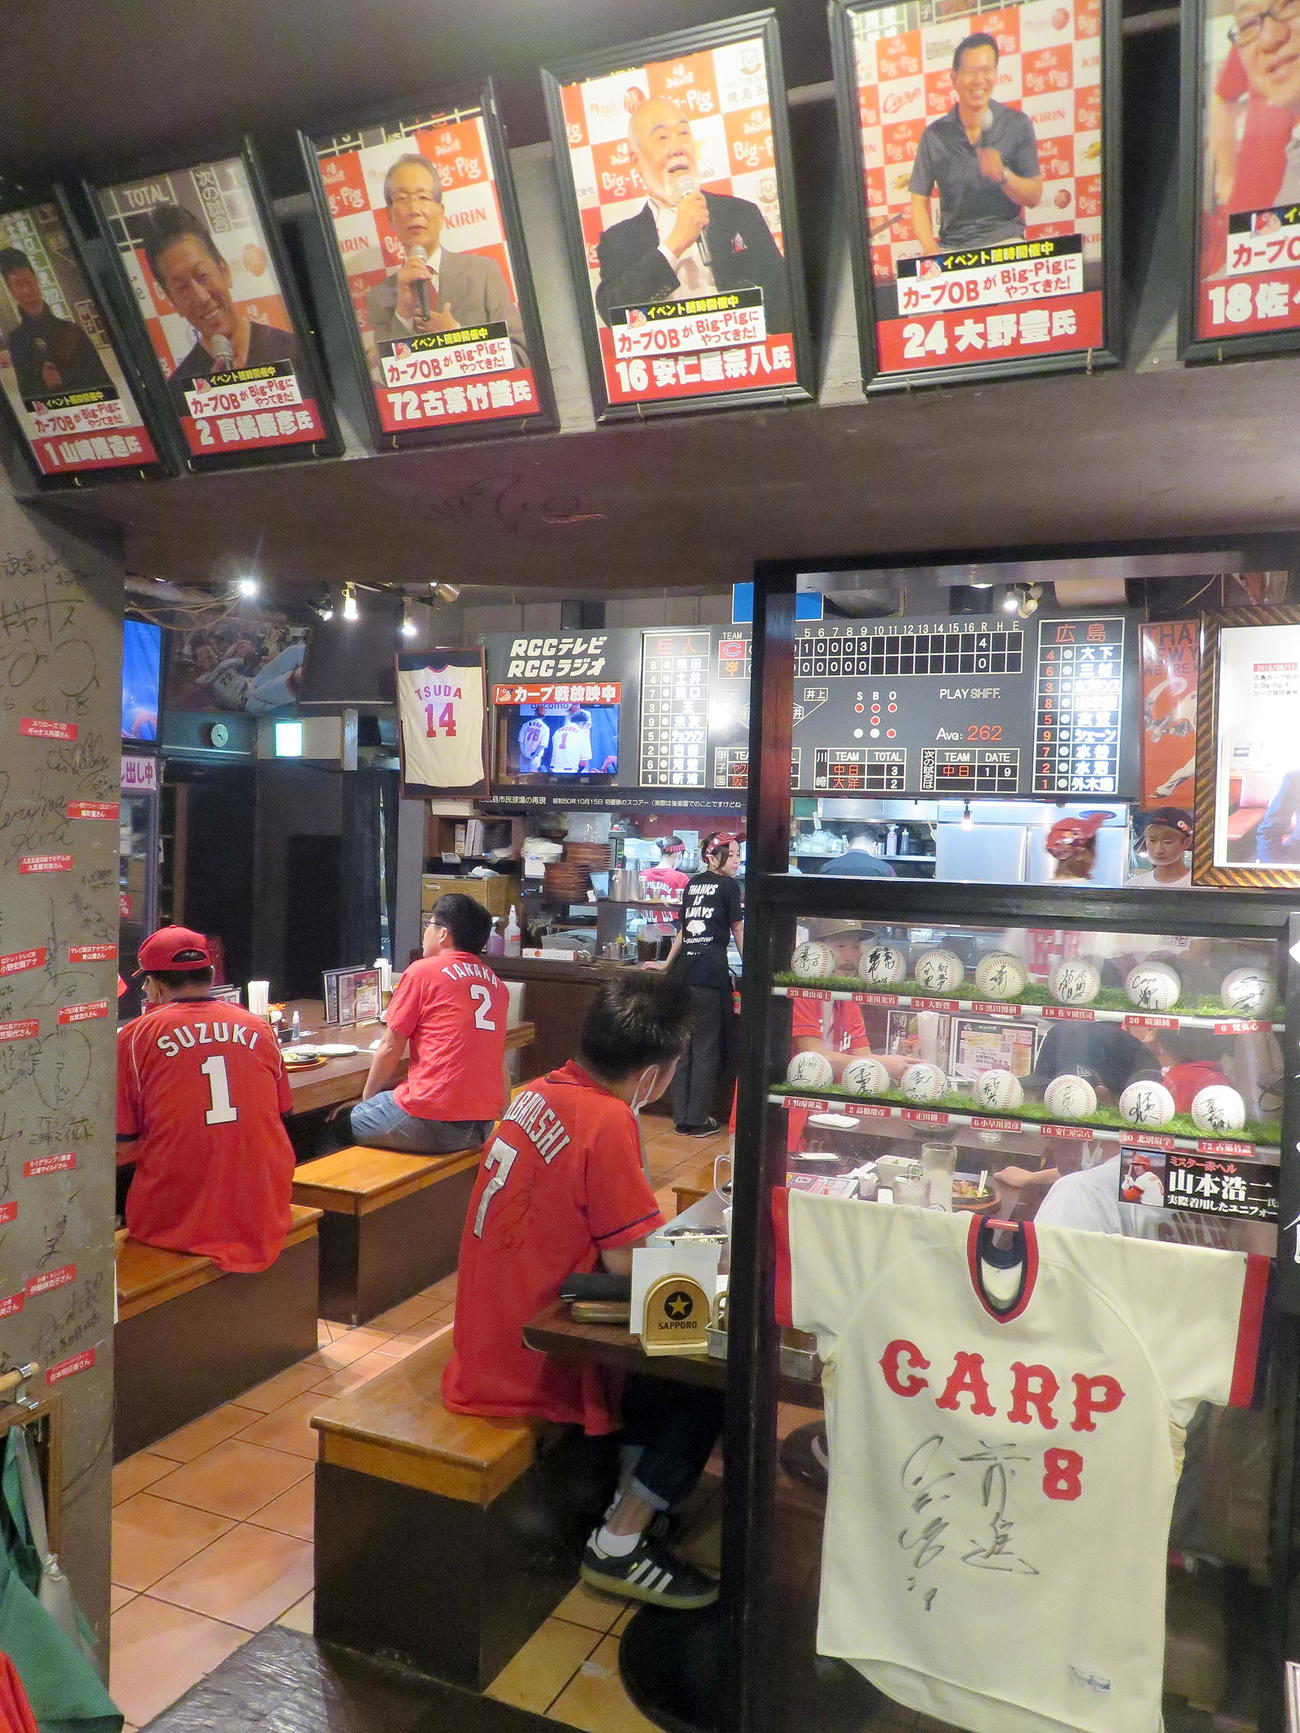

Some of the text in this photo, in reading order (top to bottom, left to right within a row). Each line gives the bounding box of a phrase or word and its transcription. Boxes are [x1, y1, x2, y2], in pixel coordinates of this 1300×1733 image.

[124, 184, 171, 208] TOTAL
[445, 208, 487, 229] KIRIN
[1209, 283, 1252, 324] 18
[902, 320, 948, 358] 24
[615, 359, 649, 393] 16
[387, 391, 421, 421] 72
[196, 419, 215, 445] 2
[44, 442, 60, 466] 1
[804, 629, 810, 637] 5
[833, 628, 839, 636] 7
[847, 627, 853, 636] 8
[861, 627, 867, 635] 9
[874, 626, 884, 635] 10
[888, 626, 898, 635] 11
[903, 626, 913, 634] 12
[918, 625, 928, 633] 13
[933, 625, 944, 633] 14
[949, 624, 959, 632] 15
[964, 623, 974, 631] 16
[981, 623, 987, 631] R
[1013, 622, 1018, 630] E
[1056, 624, 1106, 642] 広島
[658, 638, 697, 655] 巨人
[804, 638, 987, 652] 1 0 0 0 3 4
[1046, 647, 1114, 660] 4 大下
[650, 661, 656, 670] 8
[803, 659, 987, 672] 0 0 0 0 0 0
[1046, 666, 1054, 676] 6
[650, 675, 656, 684] 4
[415, 684, 463, 701] TSUDA
[650, 689, 655, 698] 7
[1045, 683, 1053, 693] 3
[514, 685, 616, 703] カープ戦放映中
[807, 689, 826, 699] 井上
[856, 692, 896, 700] S B O
[940, 689, 969, 699] PLAY
[649, 704, 655, 712] 3
[1045, 699, 1052, 709] 8
[424, 702, 457, 738] 14
[649, 718, 654, 727] 9
[1045, 715, 1052, 725] 5
[648, 732, 654, 741] 5
[966, 725, 1002, 741] 262
[1043, 729, 1117, 742] 9 シェーン
[648, 746, 654, 755] 2
[1043, 747, 1050, 757] 7
[835, 752, 902, 761] TEAM TOTAL
[944, 753, 1010, 762] TEAM DATE
[647, 760, 653, 769] 6
[1042, 763, 1050, 773] 2
[833, 765, 898, 776] 中日 3
[943, 765, 1011, 777] 中日 1 9
[647, 774, 652, 783] 1
[833, 778, 897, 789] 大洋 2
[1042, 780, 1048, 789] 1
[688, 884, 718, 895] THANKS
[693, 895, 704, 906] IS
[441, 962, 498, 989] TANAKA
[470, 984, 496, 1032] 2
[975, 1004, 984, 1012] 15
[1220, 1024, 1226, 1032] 6
[157, 1022, 259, 1058] SUZUKI
[200, 1055, 238, 1126] 1
[1201, 1142, 1213, 1151] 72
[473, 1137, 519, 1240] 7
[1169, 1169, 1273, 1202] 山本浩二
[658, 1321, 697, 1330] SAPPORO
[878, 1339, 1126, 1432] CARP
[1042, 1447, 1084, 1501] 8
